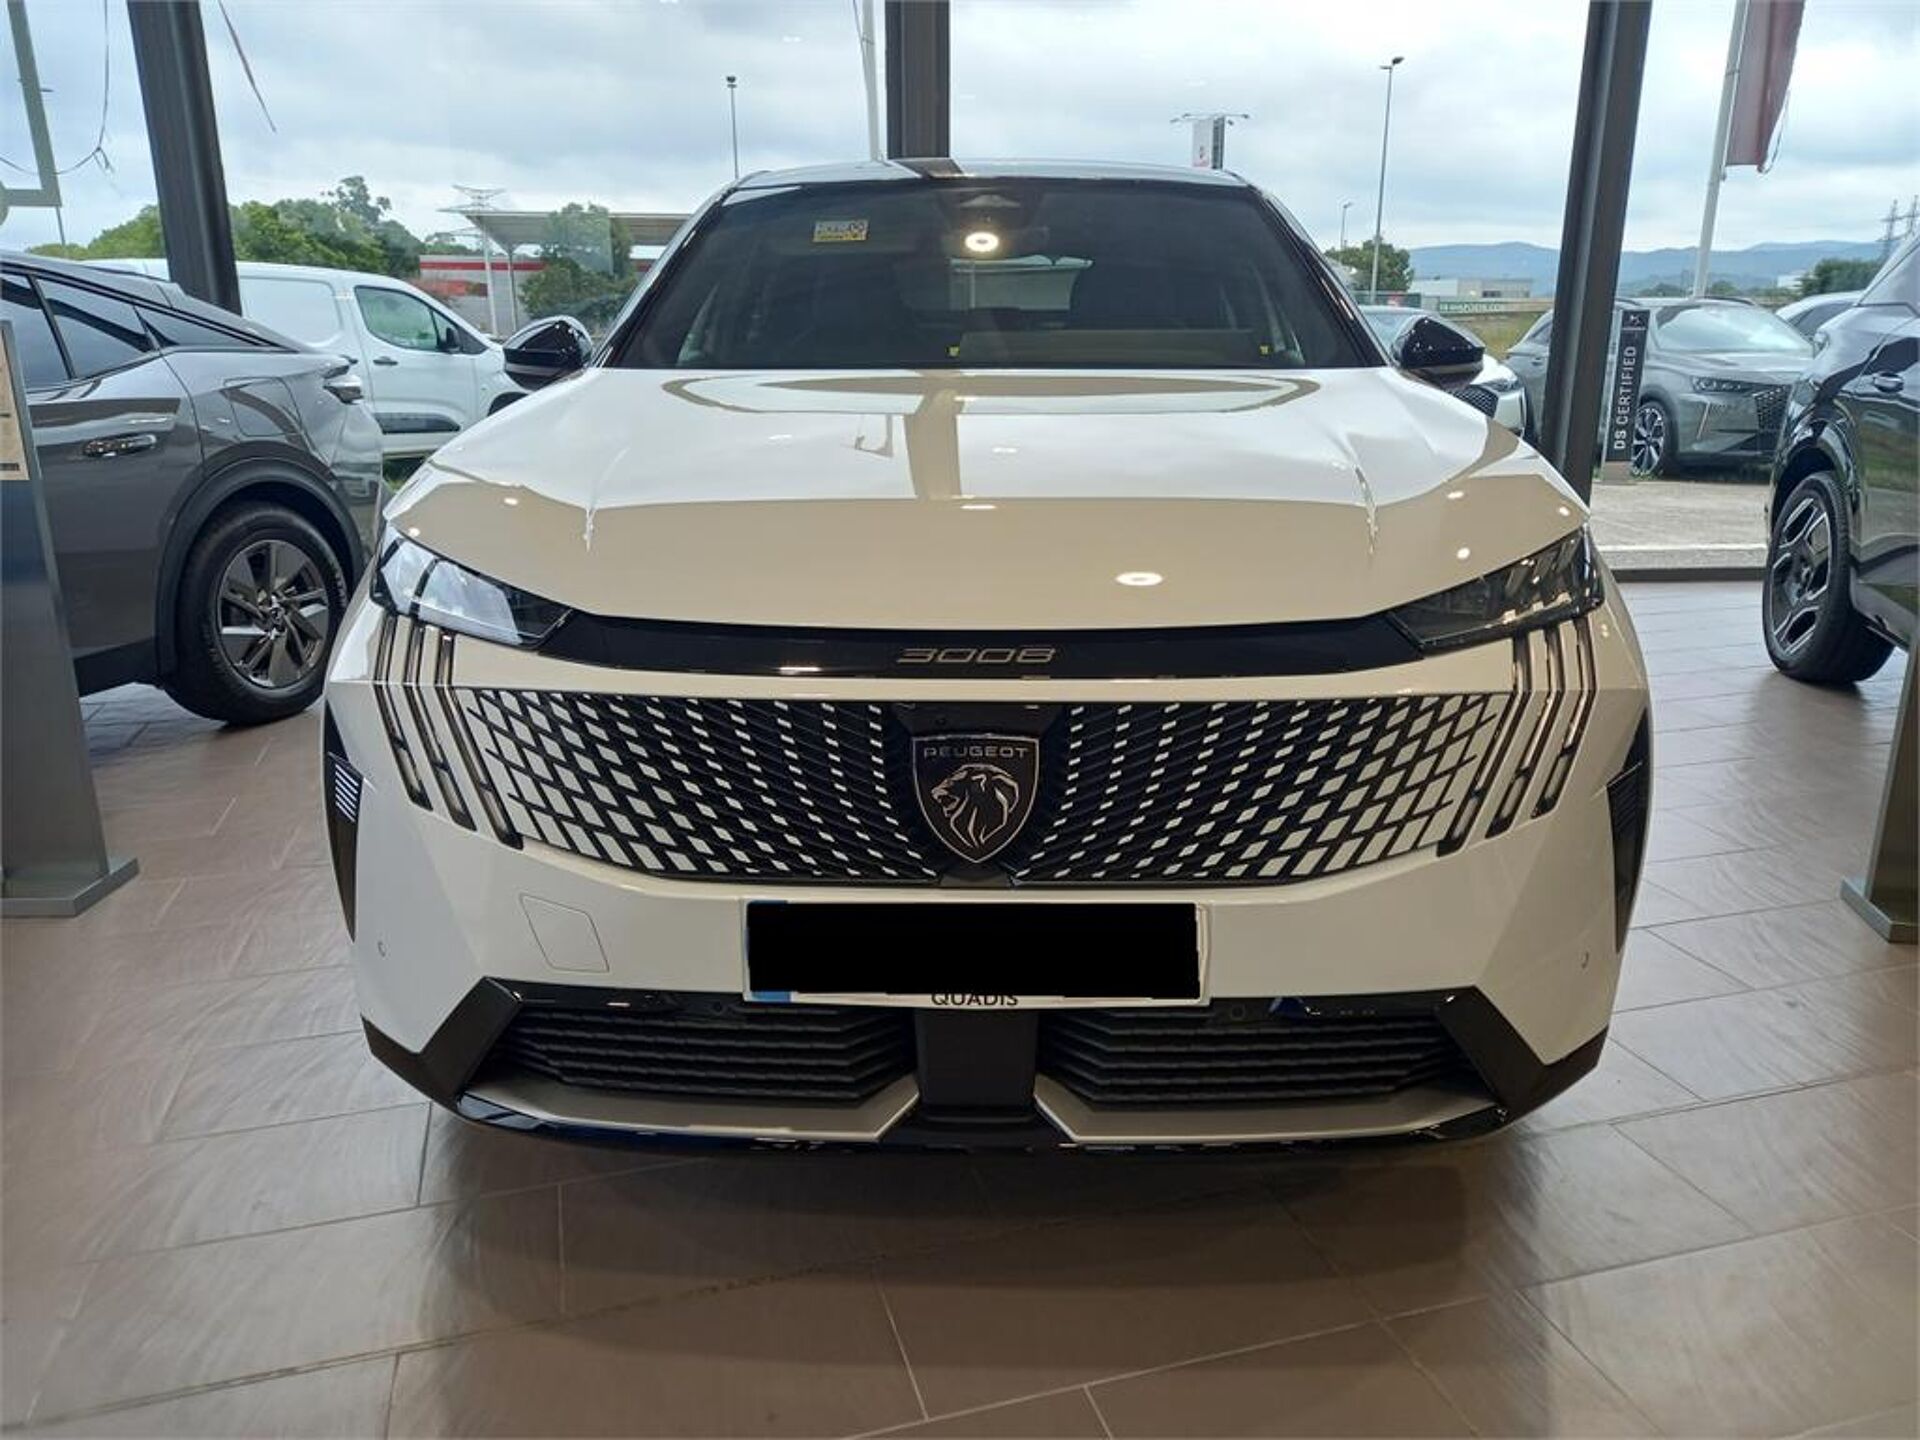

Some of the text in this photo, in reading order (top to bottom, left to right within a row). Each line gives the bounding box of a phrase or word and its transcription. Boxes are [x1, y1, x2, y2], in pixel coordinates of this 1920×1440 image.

[1614, 346, 1637, 450] DS CERTIFIED
[896, 648, 1056, 663] 3008
[923, 745, 1029, 758] PEUGEOT
[931, 992, 1019, 1006] QUADIS
